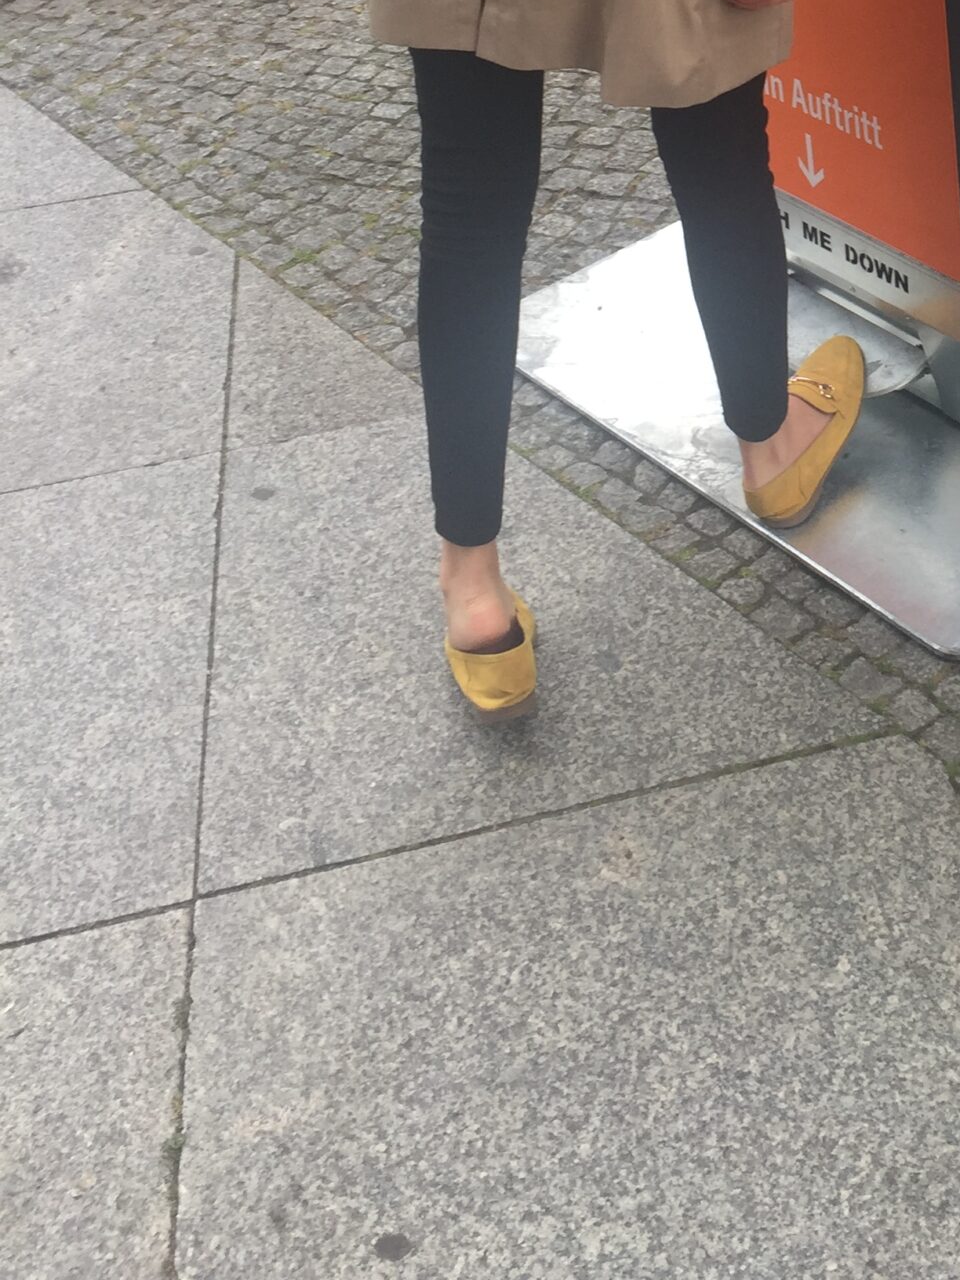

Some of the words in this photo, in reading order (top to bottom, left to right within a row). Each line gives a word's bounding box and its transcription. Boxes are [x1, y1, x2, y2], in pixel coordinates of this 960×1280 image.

[791, 78, 884, 150] Auftritt
[801, 221, 833, 253] ME
[844, 243, 910, 295] DOWN
